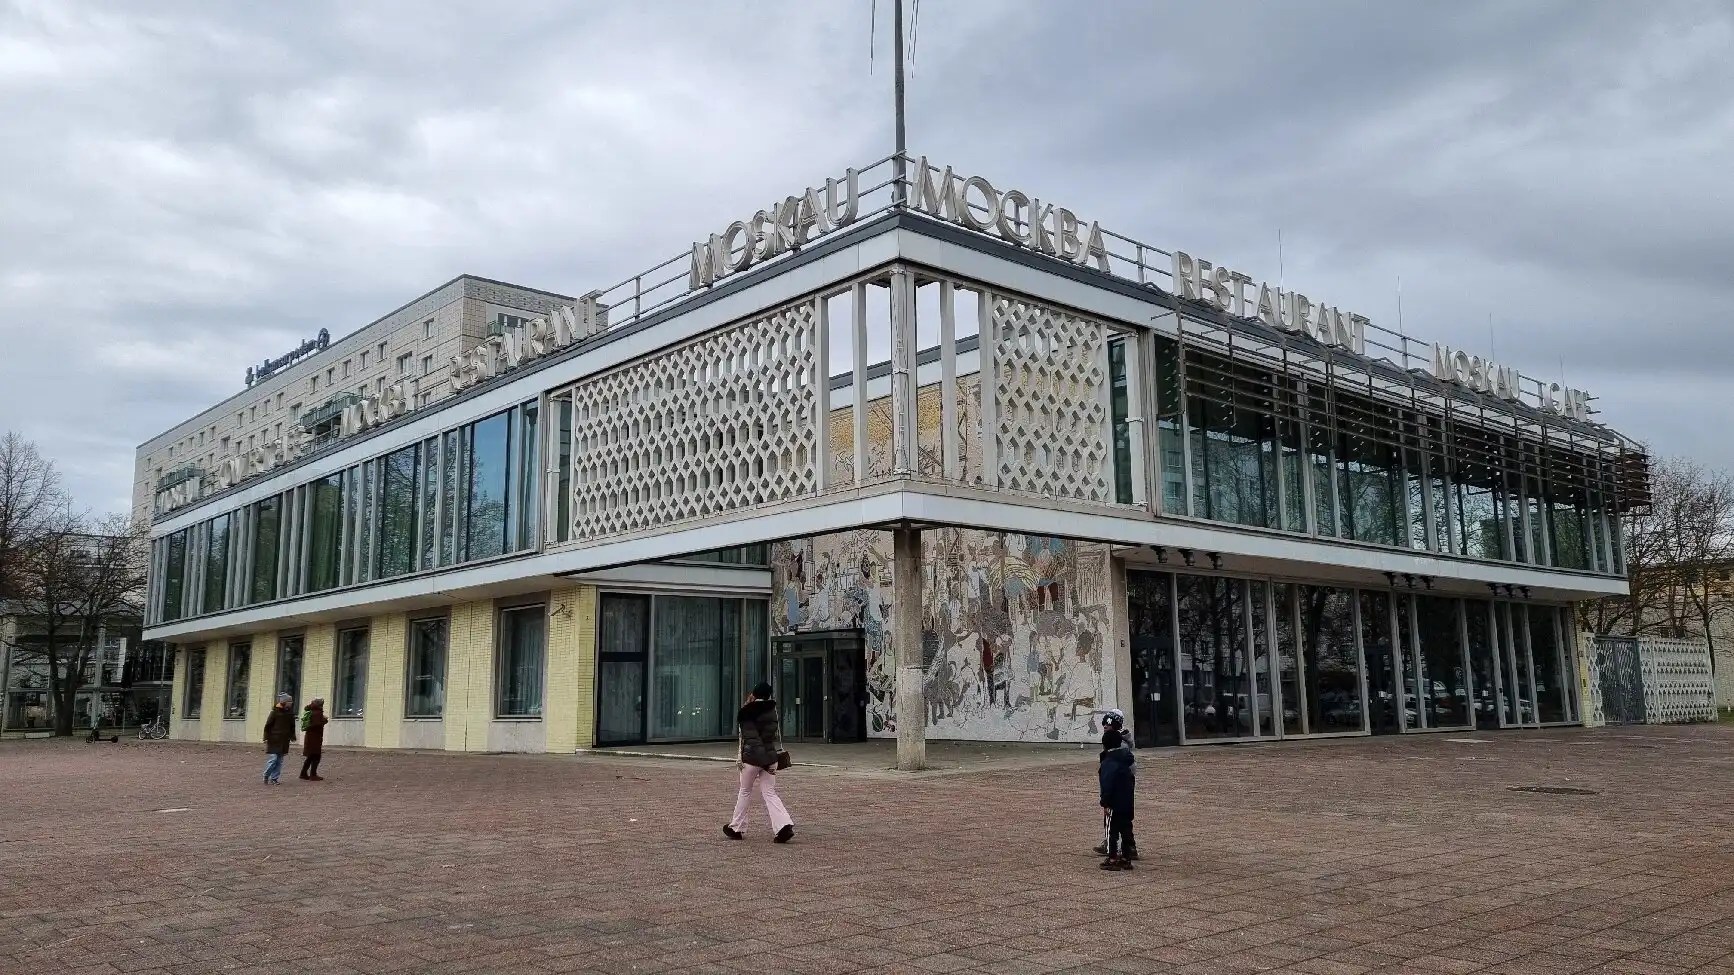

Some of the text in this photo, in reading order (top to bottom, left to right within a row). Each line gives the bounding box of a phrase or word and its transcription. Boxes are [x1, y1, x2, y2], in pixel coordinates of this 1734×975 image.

[688, 167, 859, 291] MOSKAU
[910, 155, 1111, 274] МОСКВА
[1171, 250, 1371, 356] RESTAURANT
[1429, 341, 1520, 400] MOSKAU
